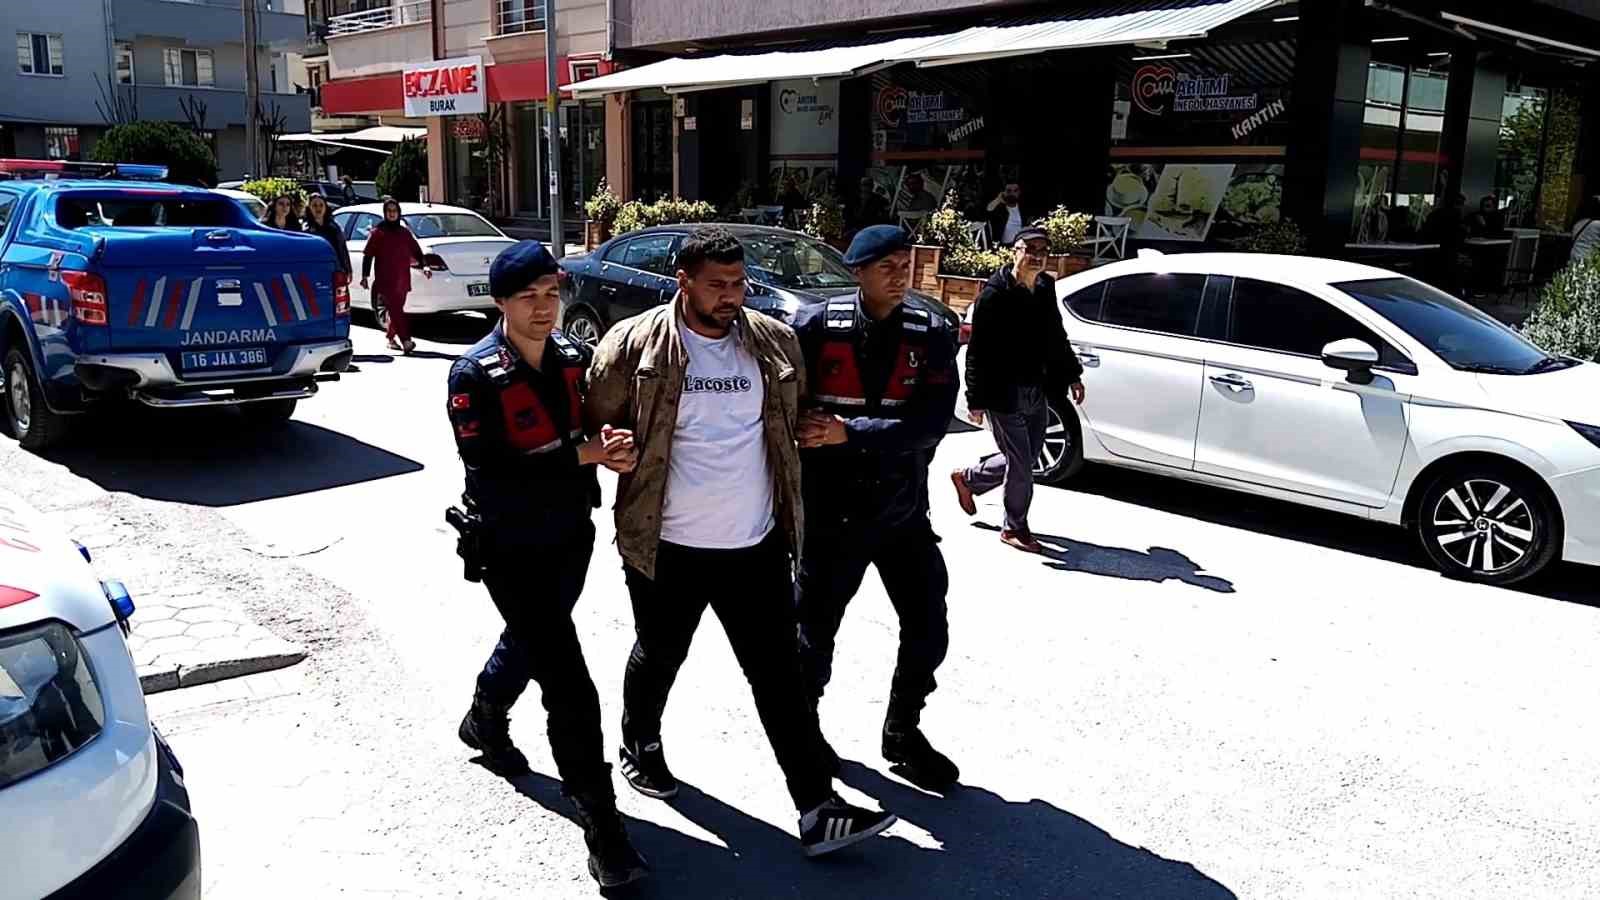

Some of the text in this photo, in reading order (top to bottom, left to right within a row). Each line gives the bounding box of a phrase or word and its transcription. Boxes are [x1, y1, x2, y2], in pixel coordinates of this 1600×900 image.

[404, 65, 478, 97] ECZANE
[430, 99, 456, 112] BURAK
[180, 328, 277, 346] JANDARMA
[191, 353, 208, 367] 16
[211, 351, 236, 366] JAA
[683, 375, 752, 393] Lacoste
